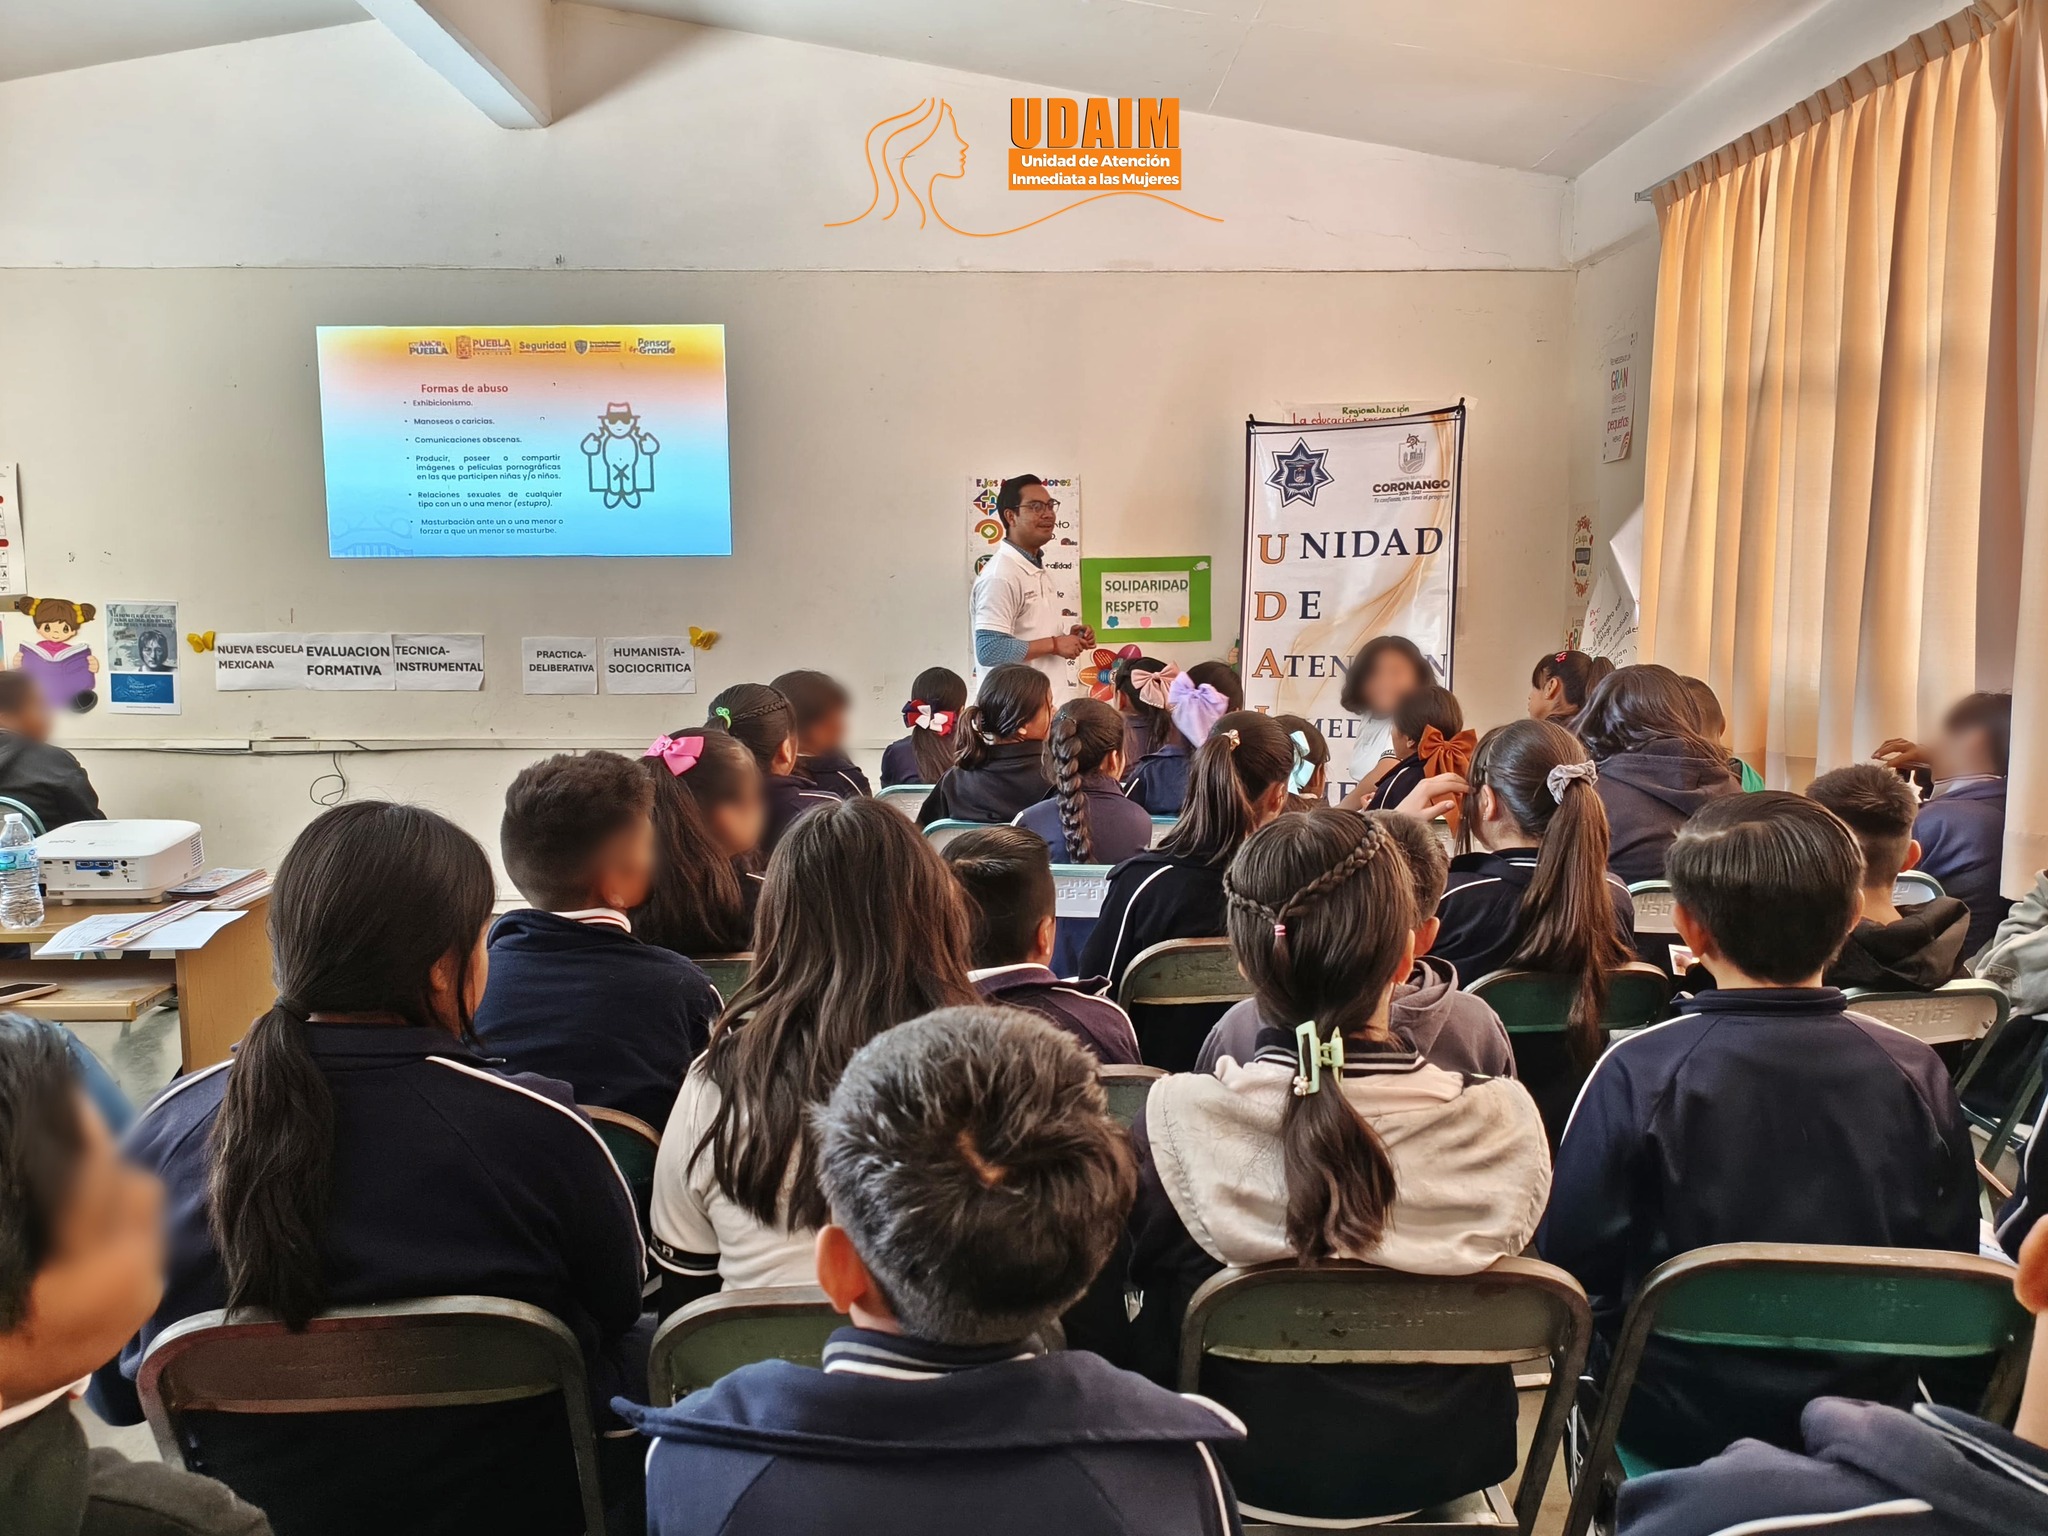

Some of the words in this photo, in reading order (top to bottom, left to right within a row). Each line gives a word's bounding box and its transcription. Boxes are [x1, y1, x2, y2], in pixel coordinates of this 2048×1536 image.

[472, 339, 511, 347] PUEBLA
[519, 340, 567, 351] Seguridad
[637, 338, 671, 347] Pensar
[409, 347, 449, 355] PUEBLA
[639, 346, 676, 354] Grande
[421, 384, 458, 393] Formas
[461, 384, 474, 393] de
[477, 384, 508, 393] abuso
[412, 399, 473, 407] Exhibicionismo.
[1342, 404, 1410, 417] Regionalización
[1292, 412, 1307, 425] La
[415, 455, 450, 463] Producir,
[521, 455, 561, 463] compartir
[416, 464, 455, 472] imágenes
[506, 463, 561, 472] pornográficas
[458, 473, 498, 481] participen
[499, 472, 521, 480] niñas
[522, 471, 536, 481] y/o
[537, 472, 561, 480] niños.
[976, 478, 999, 489] Ejes
[1372, 479, 1451, 493] CORONANGO
[525, 491, 562, 499] cualquier
[418, 500, 434, 509] tipo
[513, 499, 553, 508] (estupro).
[421, 518, 475, 526] Masturbación
[419, 527, 442, 535] forzar
[450, 528, 466, 536] que
[1104, 579, 1189, 592] SOLIDARIDAD
[1105, 600, 1159, 612] RESPETO
[1254, 590, 1321, 622] DE
[217, 645, 254, 655] NUEVA
[255, 644, 304, 654] ESCUELA
[306, 646, 390, 657] EVALUACION
[394, 646, 450, 656] TECNICA-
[536, 650, 587, 659] PRACTICA-
[613, 647, 685, 657] HUMANISTA-
[218, 660, 274, 669] MEXICANA
[396, 662, 484, 672] INSTRUMENTAL
[529, 663, 595, 672] DELIBERATIVA
[608, 663, 692, 673] SOCIOCRITICA
[306, 665, 382, 676] FORMATIVA
